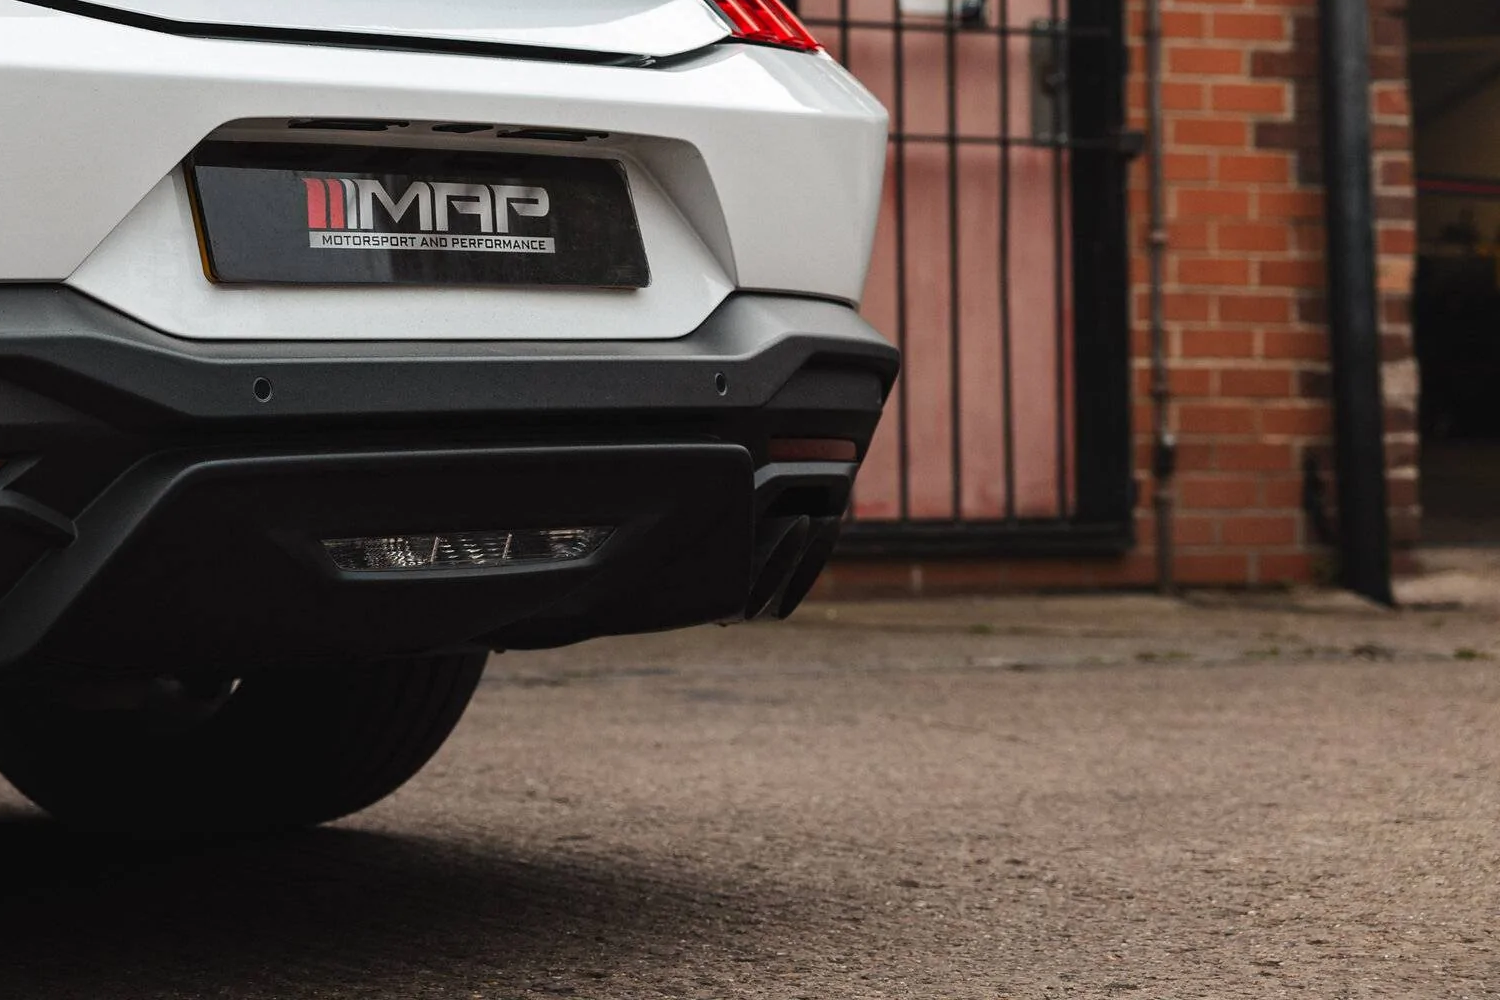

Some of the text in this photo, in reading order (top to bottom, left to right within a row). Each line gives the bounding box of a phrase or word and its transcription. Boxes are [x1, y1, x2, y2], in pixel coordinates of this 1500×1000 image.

[352, 178, 550, 234] MAP
[321, 234, 547, 251] MOTORSPORT AND PERFORMANCE
